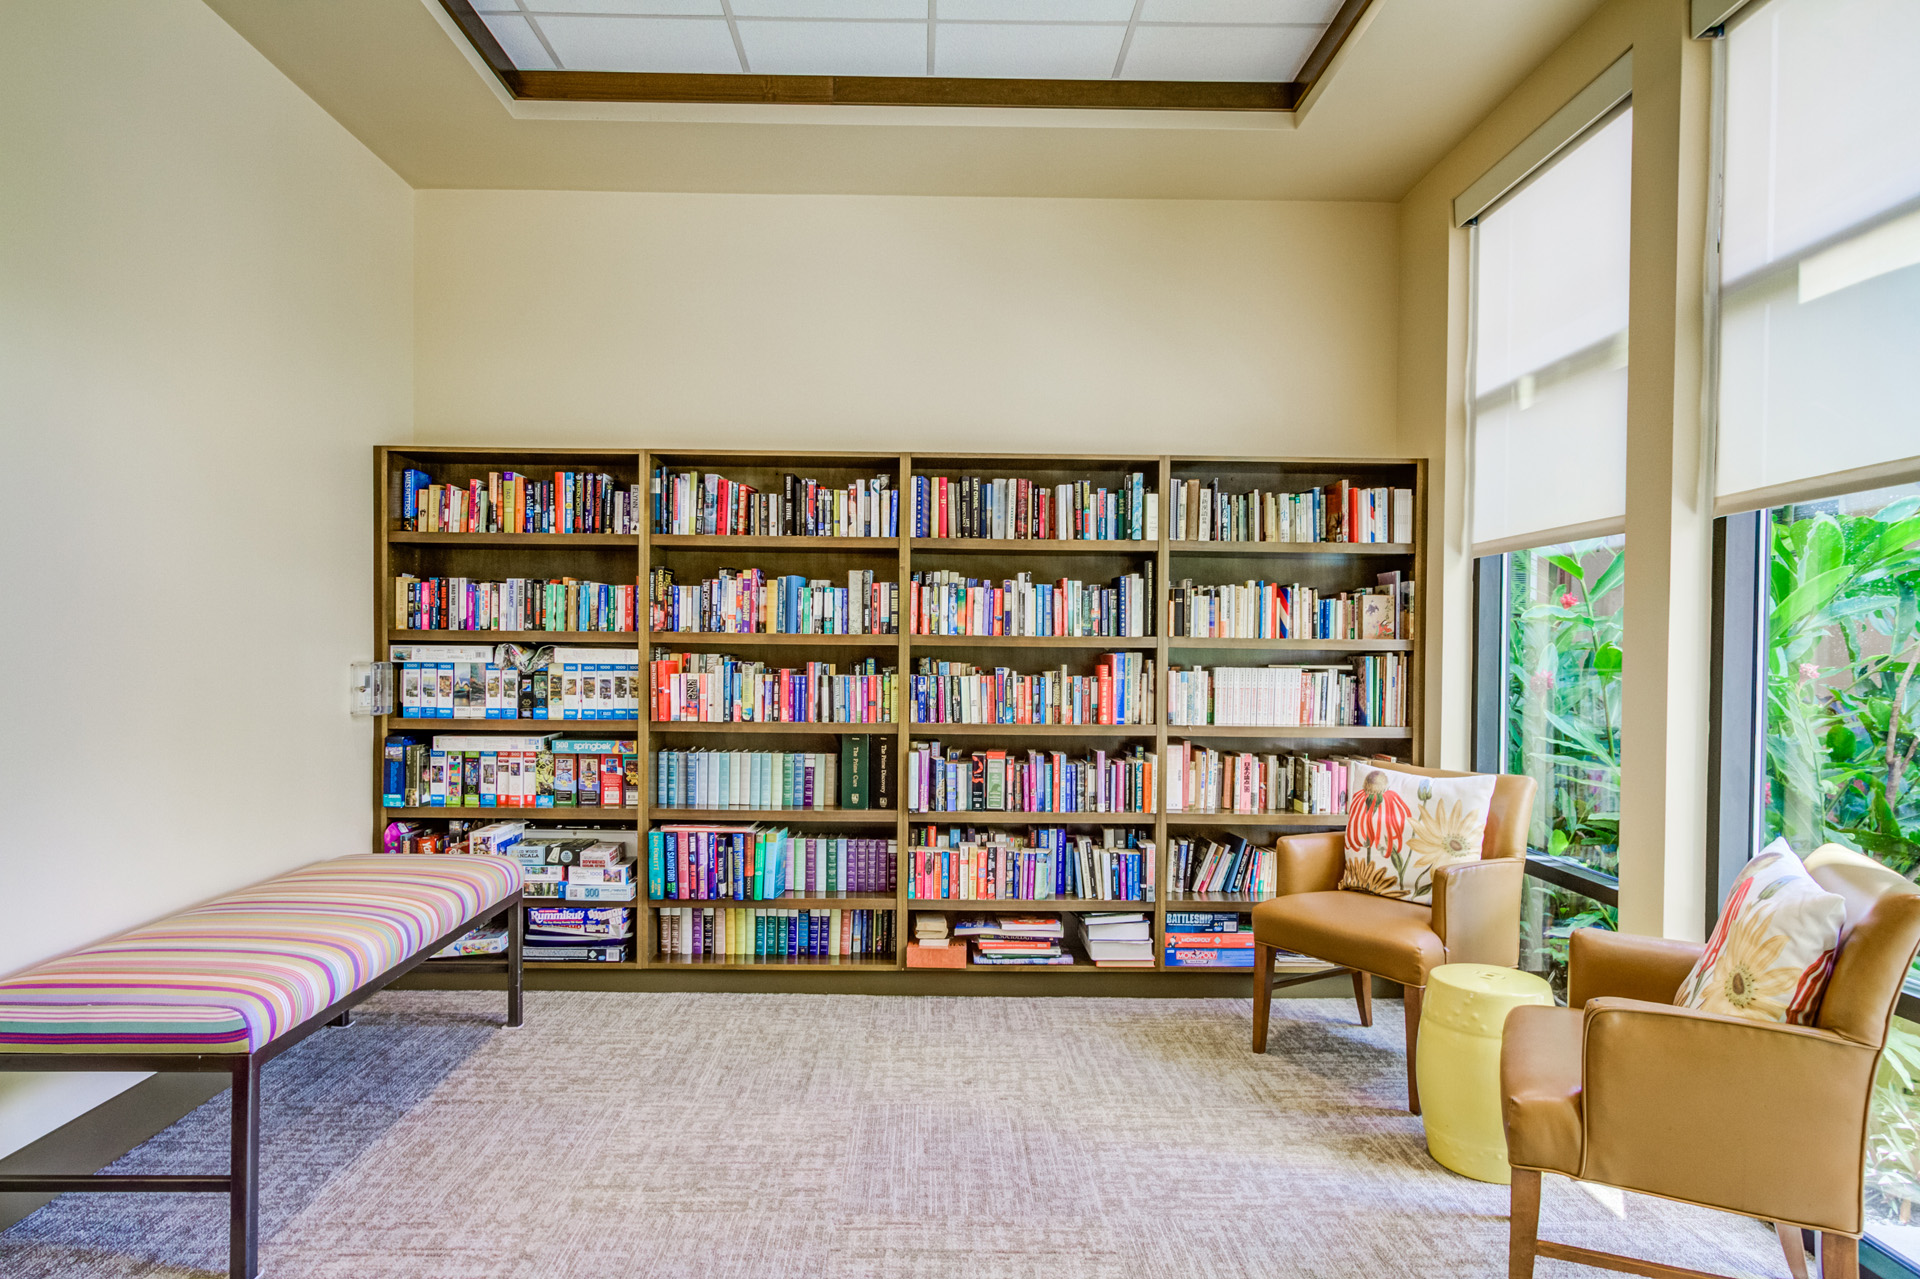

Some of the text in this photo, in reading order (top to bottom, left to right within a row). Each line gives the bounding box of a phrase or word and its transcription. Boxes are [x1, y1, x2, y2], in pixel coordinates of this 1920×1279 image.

[404, 471, 412, 519] JAMES PATTERSON
[573, 742, 611, 751] springbok
[667, 835, 675, 881] JOHN SANDFORD
[679, 838, 688, 872] DIANA PALMER
[584, 888, 599, 897] 300
[531, 910, 585, 924] Rummikub
[1166, 913, 1214, 924] BATTLESHIP
